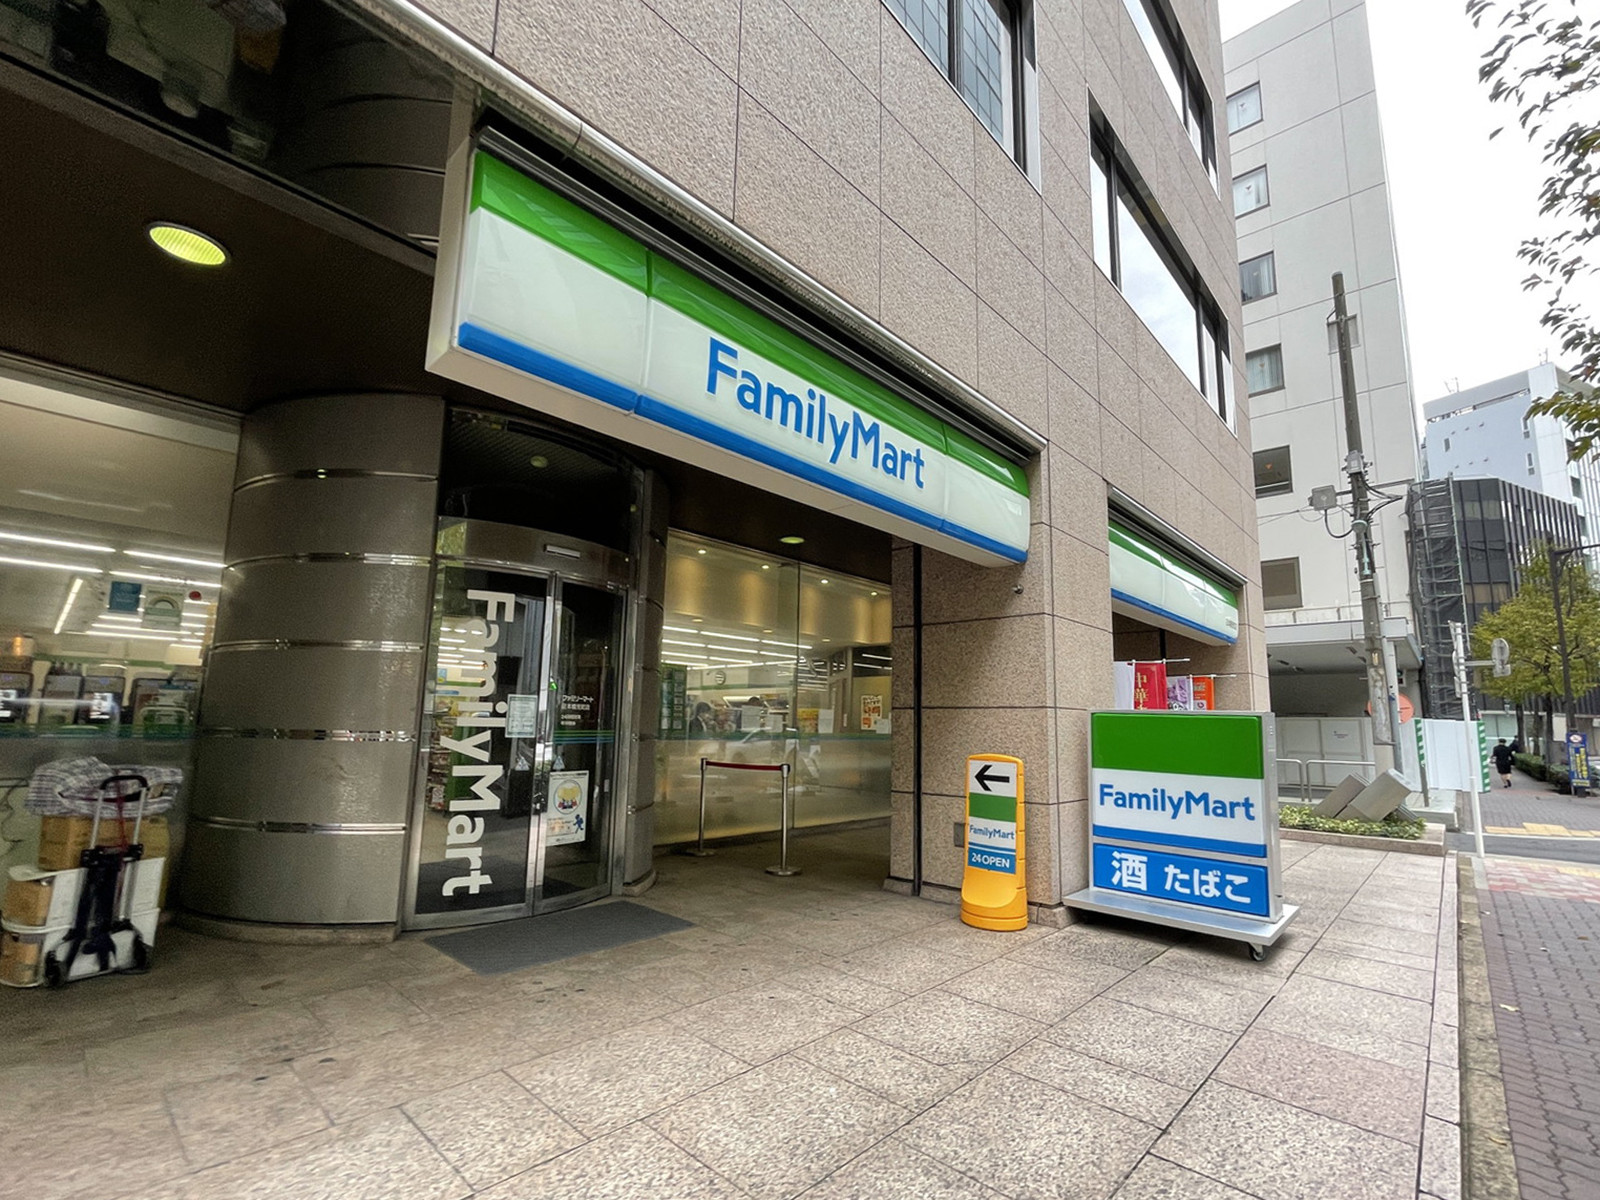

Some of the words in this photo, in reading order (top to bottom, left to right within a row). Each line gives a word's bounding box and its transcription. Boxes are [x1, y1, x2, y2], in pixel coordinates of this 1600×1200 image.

[706, 336, 925, 489] FamilyMart
[440, 589, 516, 896] FamilyMart
[1099, 784, 1256, 821] FamilyMart
[969, 824, 1015, 840] FamilyMart
[1111, 850, 1148, 891] 酒
[1164, 864, 1251, 904] たばこ
